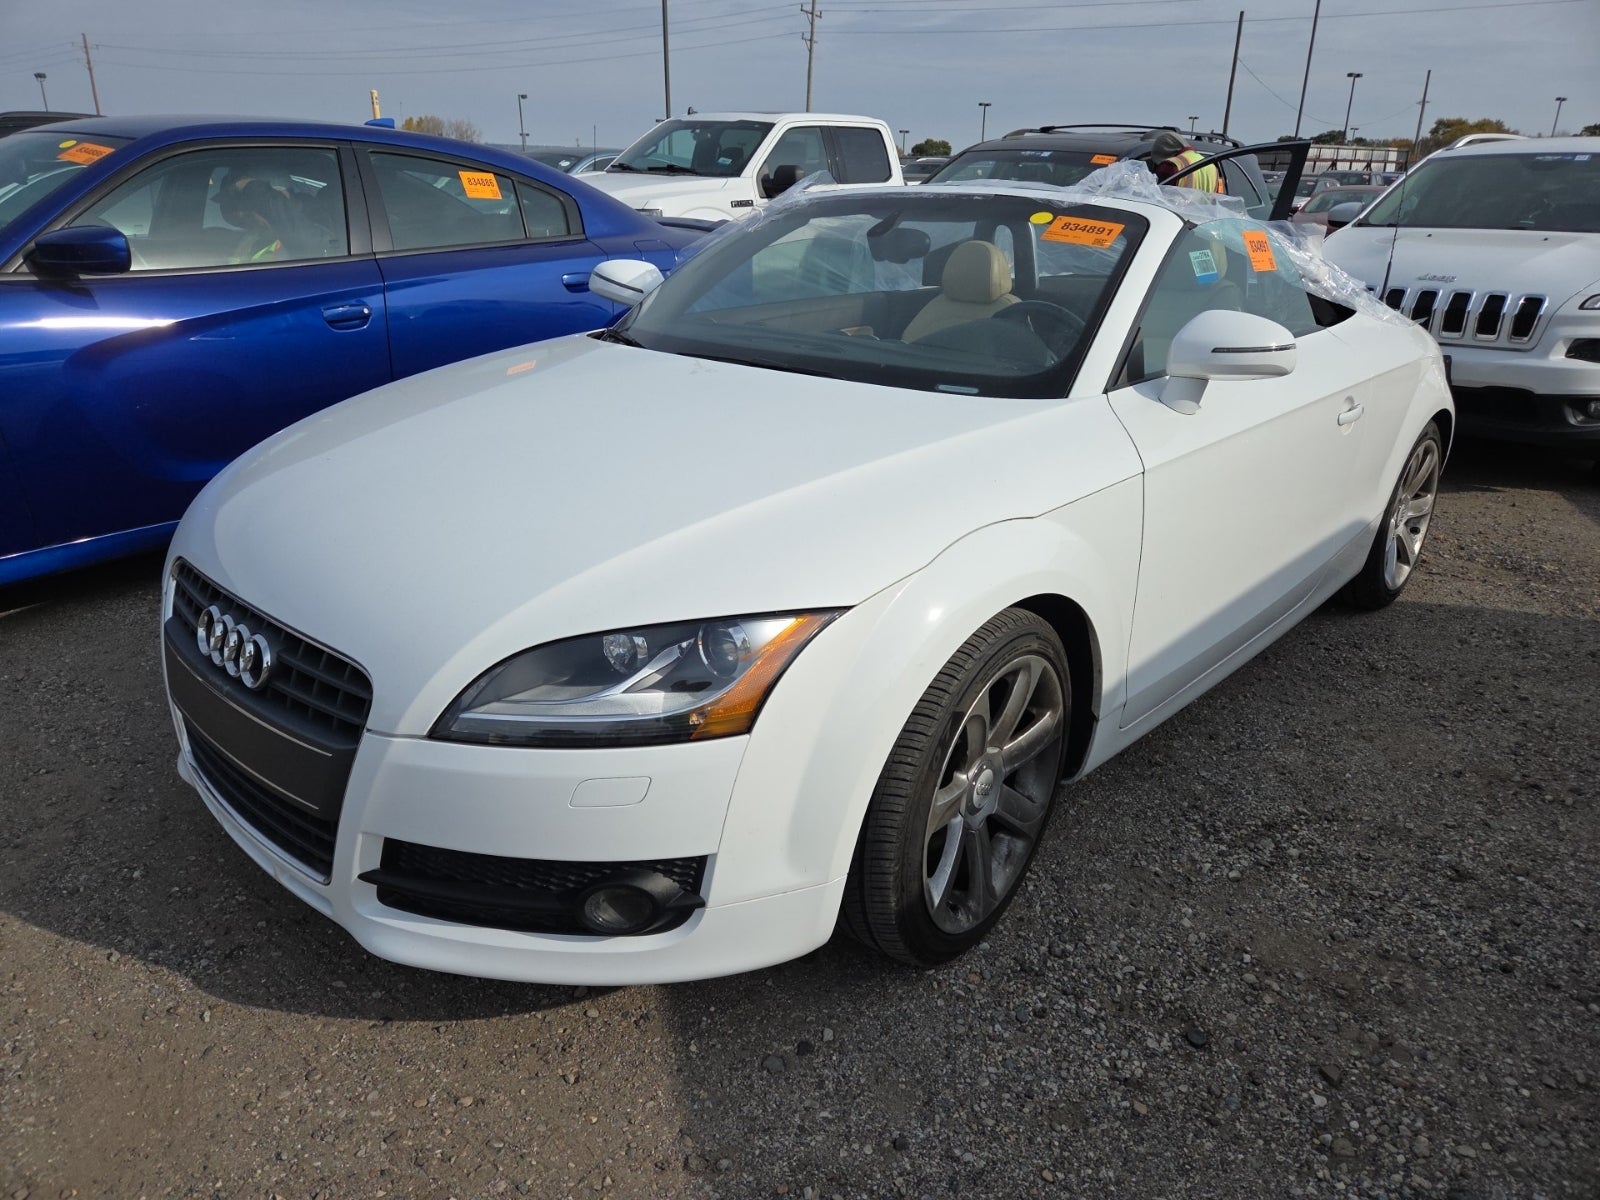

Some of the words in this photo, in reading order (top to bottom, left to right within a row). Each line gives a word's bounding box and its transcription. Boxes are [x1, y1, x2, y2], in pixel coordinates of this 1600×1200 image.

[467, 177, 495, 187] 834886
[1061, 222, 1114, 236] 834891
[1249, 239, 1269, 253] 834891
[1417, 273, 1457, 283] Jeep
